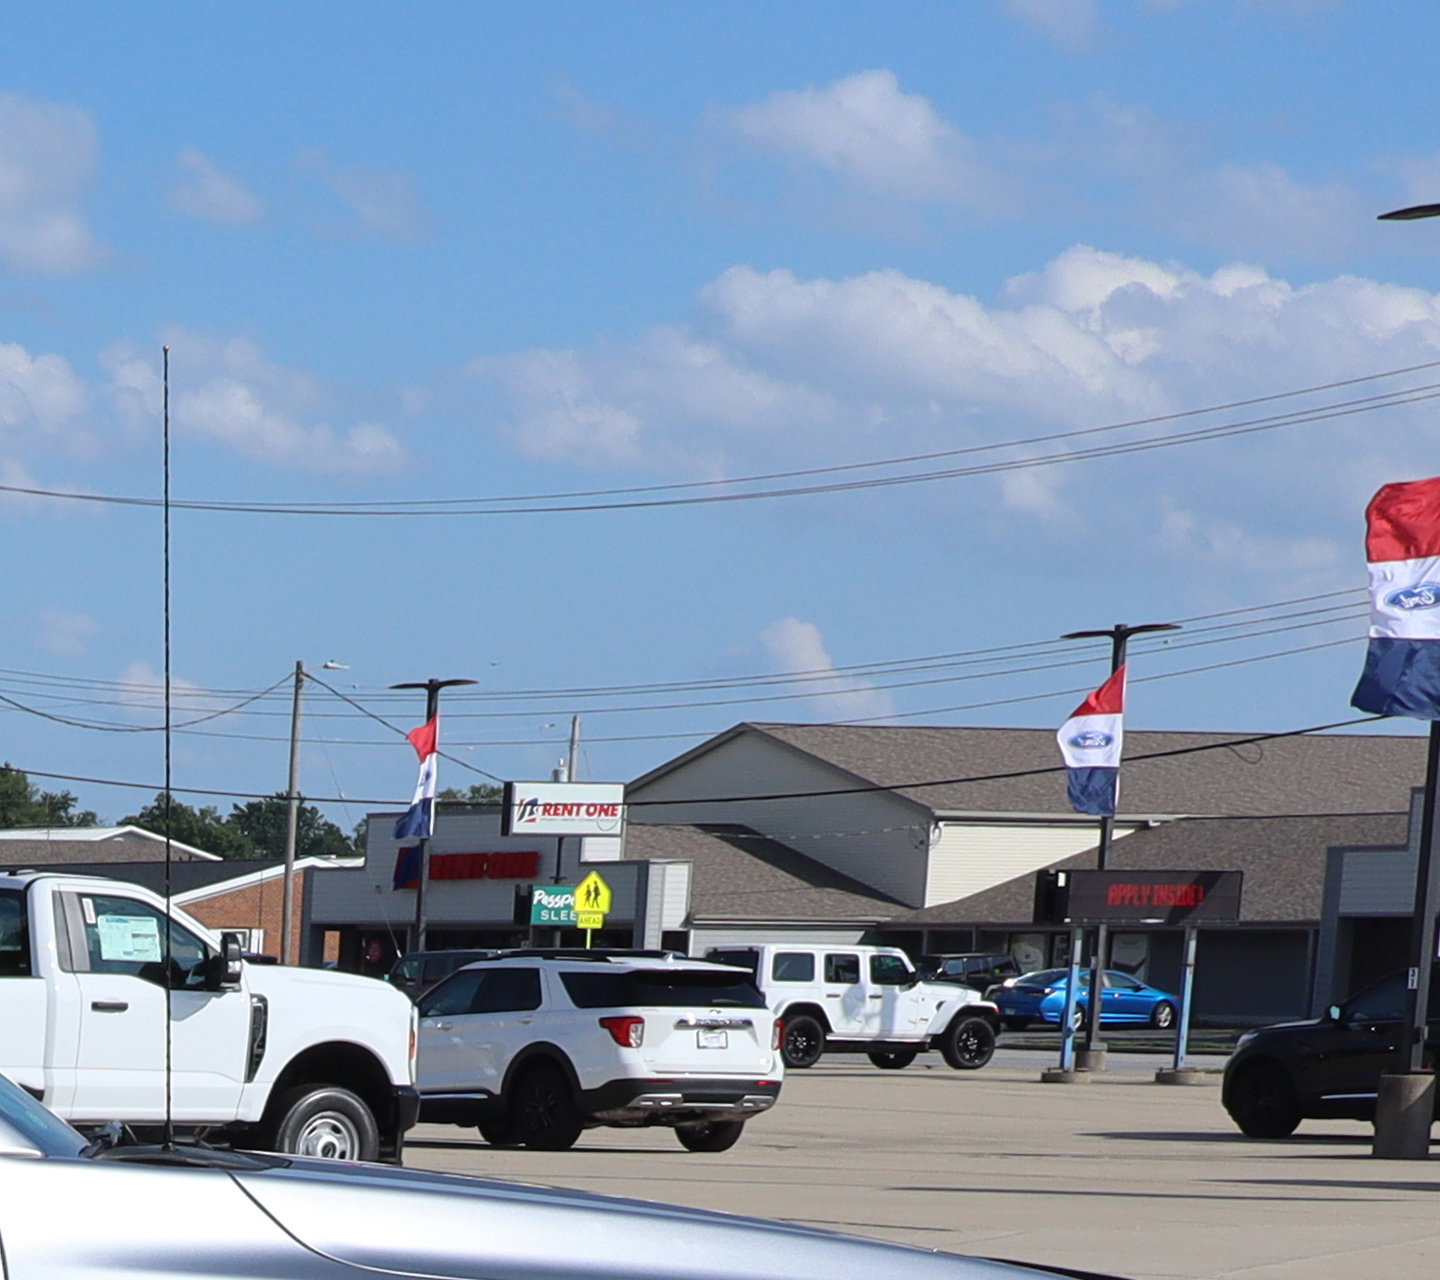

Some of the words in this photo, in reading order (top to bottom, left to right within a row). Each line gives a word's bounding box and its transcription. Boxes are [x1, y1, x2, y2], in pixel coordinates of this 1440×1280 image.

[541, 803, 584, 817] RENT
[585, 803, 619, 817] ONE
[1107, 884, 1151, 906] APPLY
[541, 910, 577, 921] SLEE
